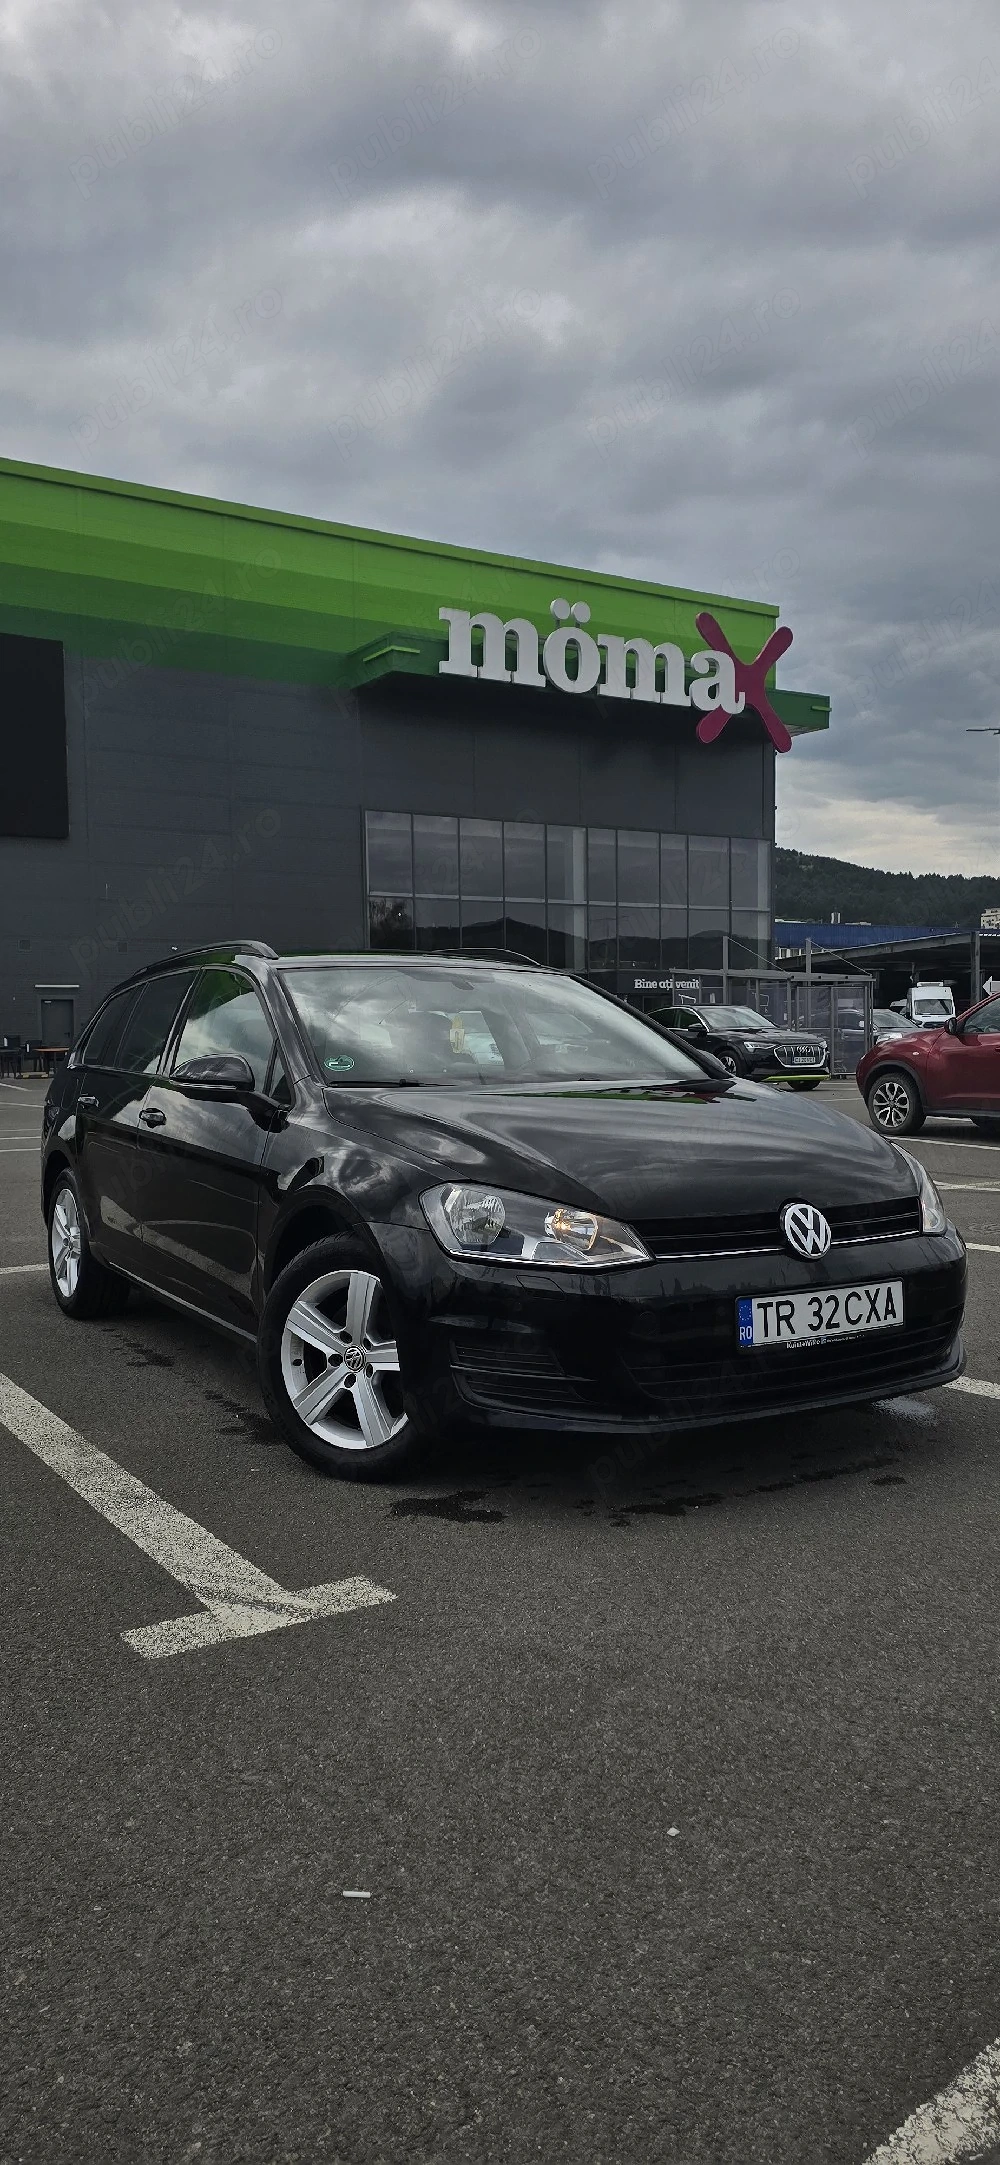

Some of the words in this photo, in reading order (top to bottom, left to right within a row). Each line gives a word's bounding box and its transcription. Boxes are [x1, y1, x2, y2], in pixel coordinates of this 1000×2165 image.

[634, 979, 658, 989] Bine
[757, 1300, 796, 1338] TR
[739, 1325, 753, 1341] RO
